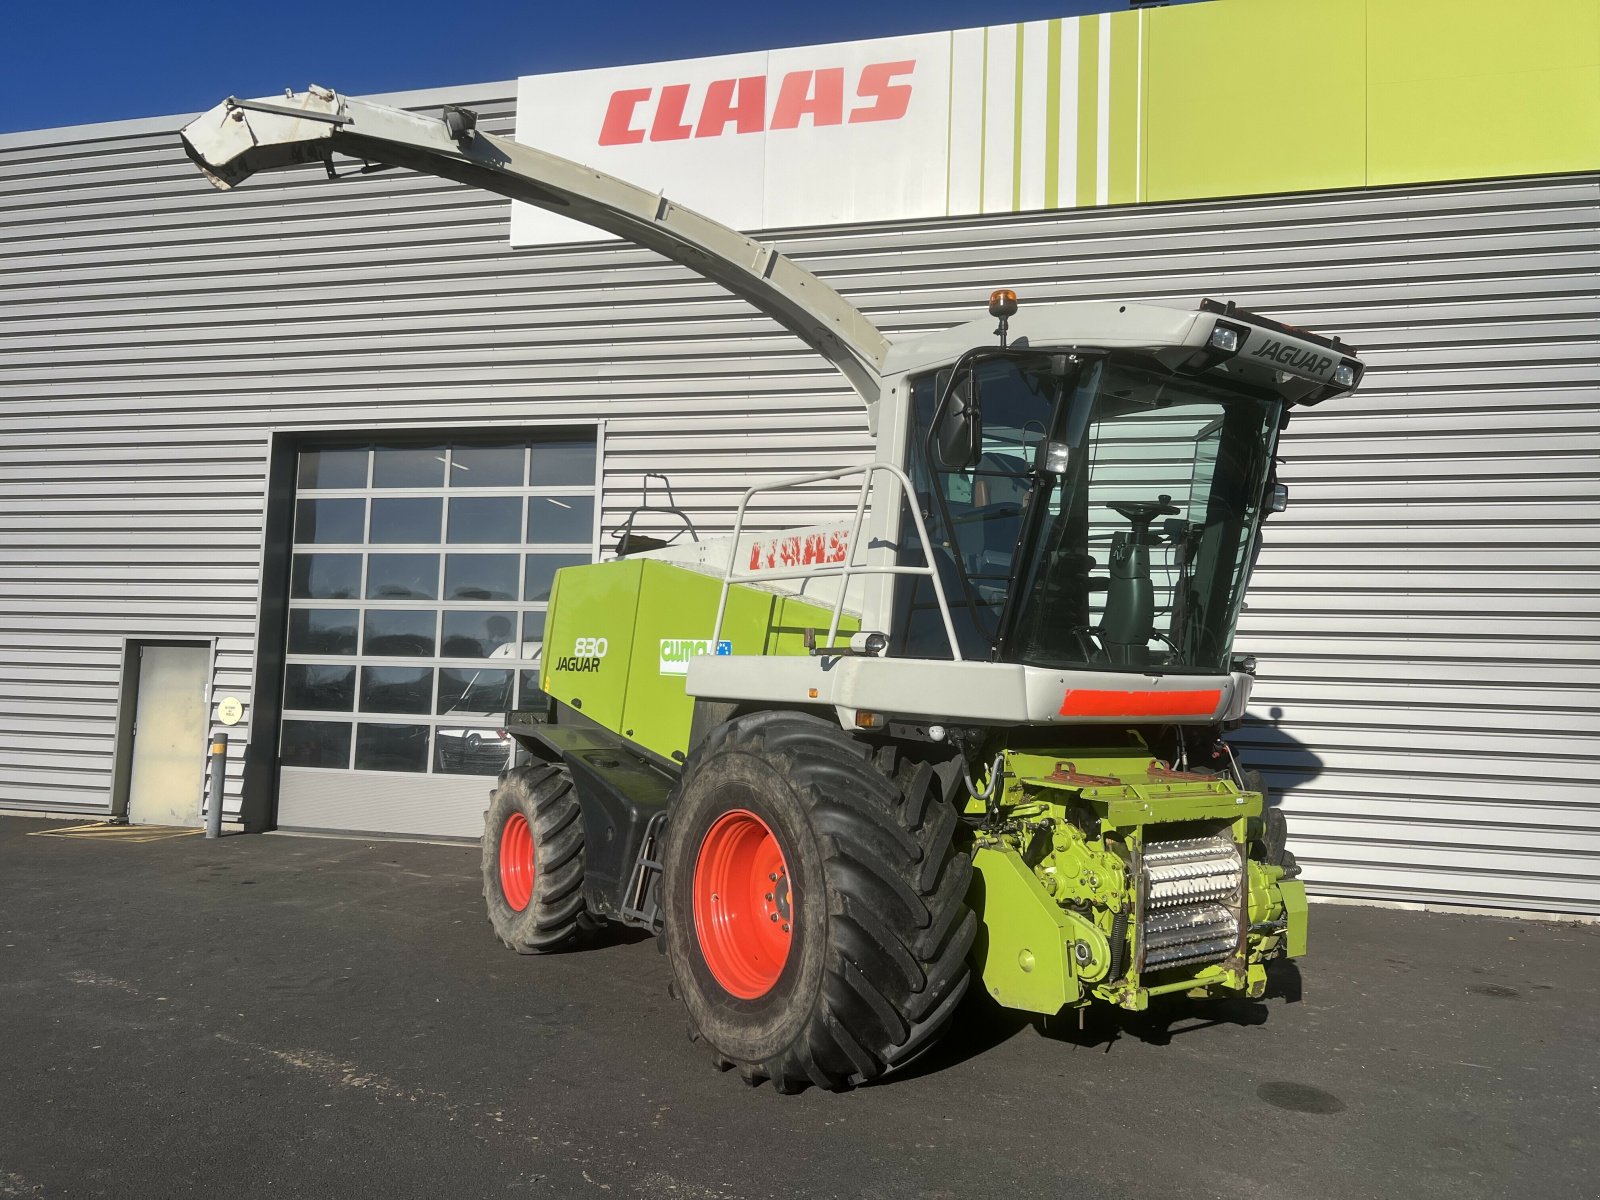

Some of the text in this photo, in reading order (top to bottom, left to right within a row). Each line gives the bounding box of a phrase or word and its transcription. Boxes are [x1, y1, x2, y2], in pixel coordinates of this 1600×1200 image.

[598, 59, 916, 146] CLAAS
[1252, 339, 1332, 376] JAGUAR
[574, 637, 608, 657] 830
[555, 656, 600, 672] JAGUAR
